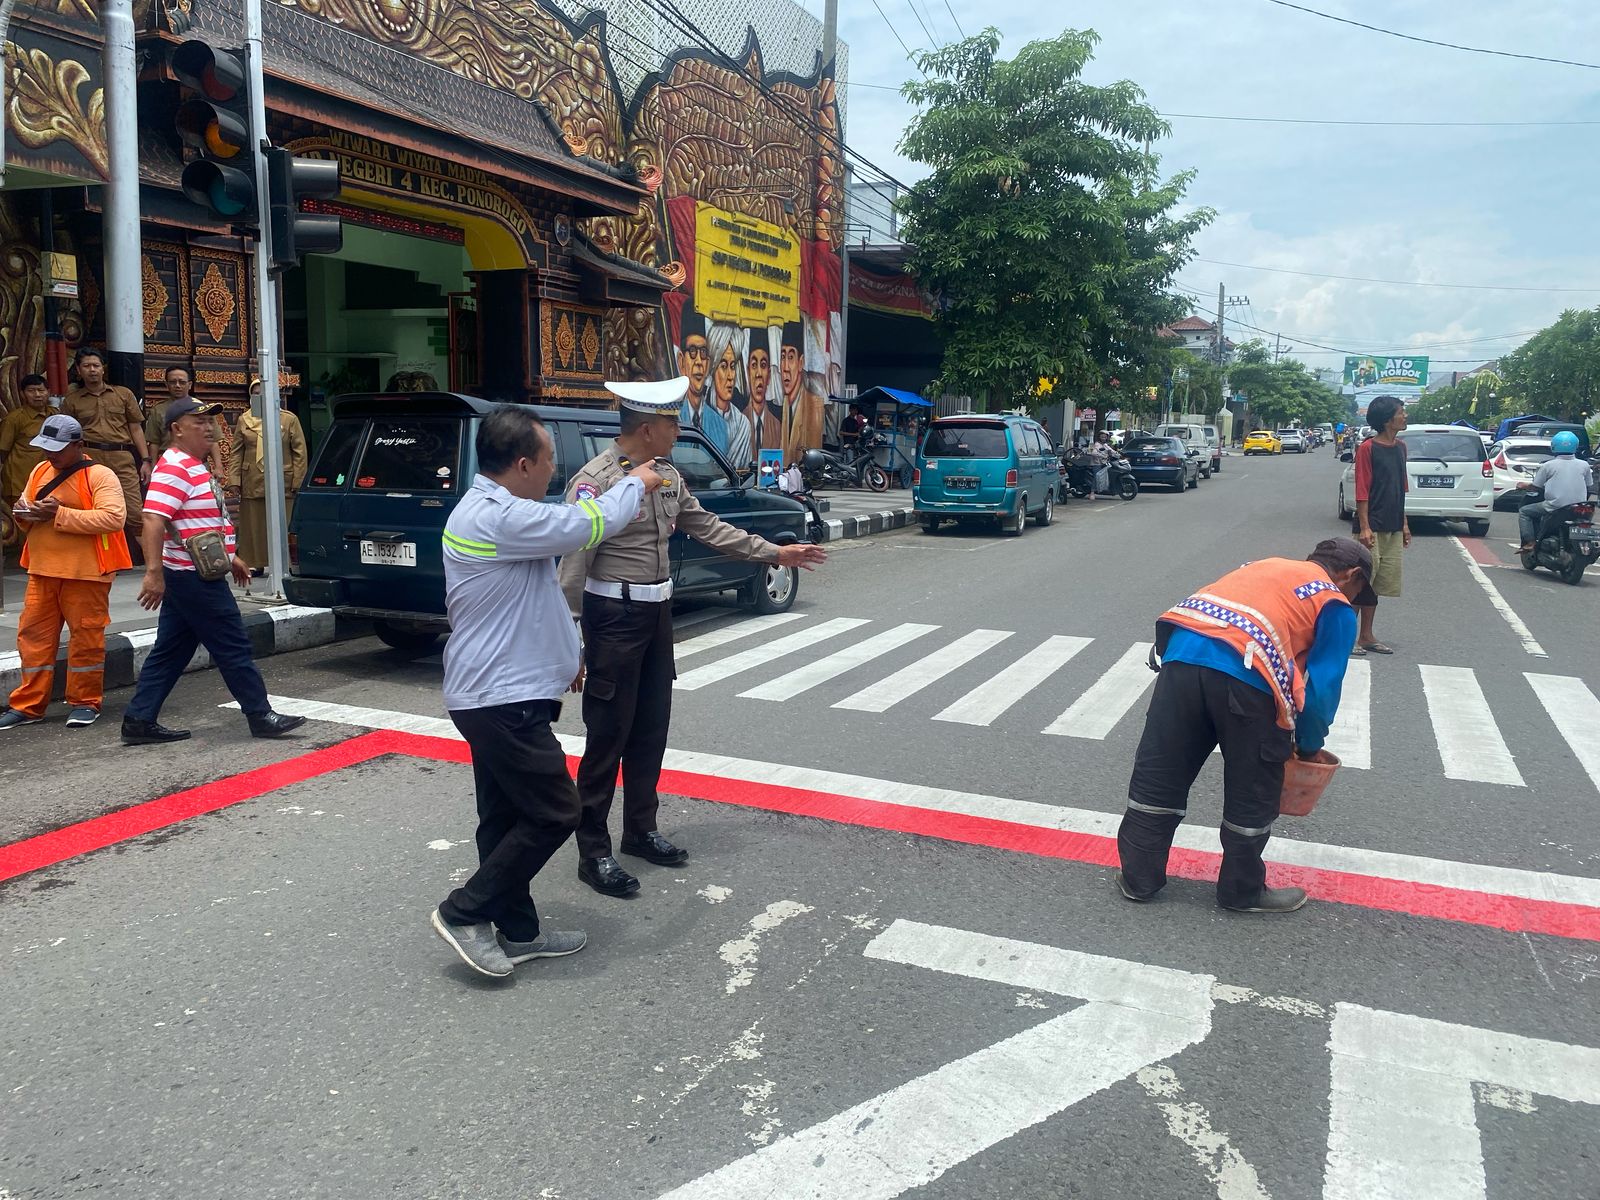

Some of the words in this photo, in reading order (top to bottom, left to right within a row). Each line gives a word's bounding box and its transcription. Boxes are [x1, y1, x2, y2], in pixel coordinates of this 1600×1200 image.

[329, 128, 391, 161] WIWARA
[396, 148, 441, 173] WIYATA
[447, 162, 489, 186] MADYA
[401, 171, 413, 190] 4
[420, 175, 455, 201] KEC.
[457, 185, 527, 235] PONOROGO
[1380, 368, 1422, 378] MONDOK
[1385, 358, 1413, 369] AYO
